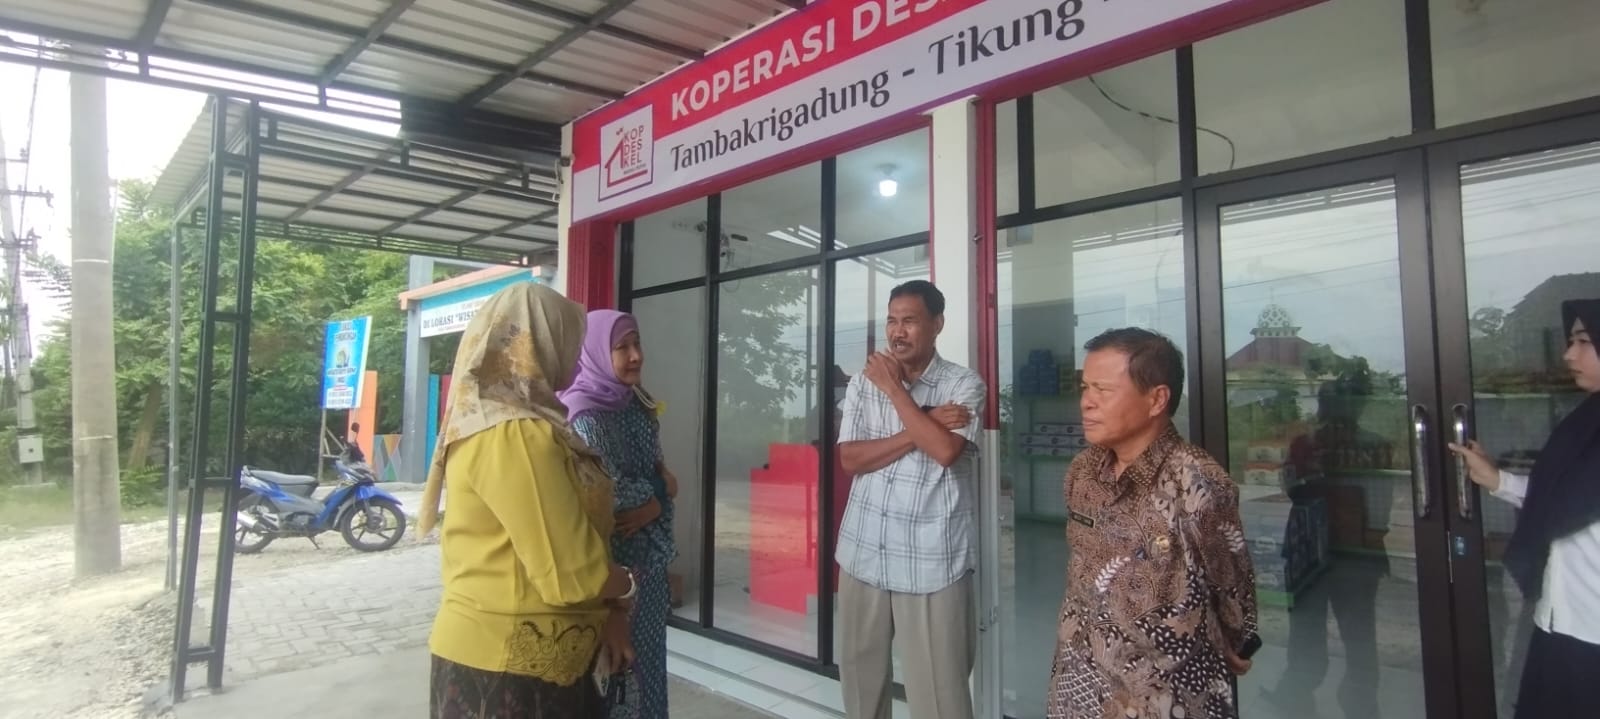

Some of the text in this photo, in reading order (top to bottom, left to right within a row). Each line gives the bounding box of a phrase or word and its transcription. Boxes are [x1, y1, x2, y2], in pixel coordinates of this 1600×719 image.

[671, 0, 946, 121] KOPERASI DE
[671, 70, 891, 172] Tambakrigadung
[928, 0, 1085, 75] Tikung
[624, 125, 645, 142] KOP
[624, 139, 642, 155] DES
[624, 153, 642, 167] KEL
